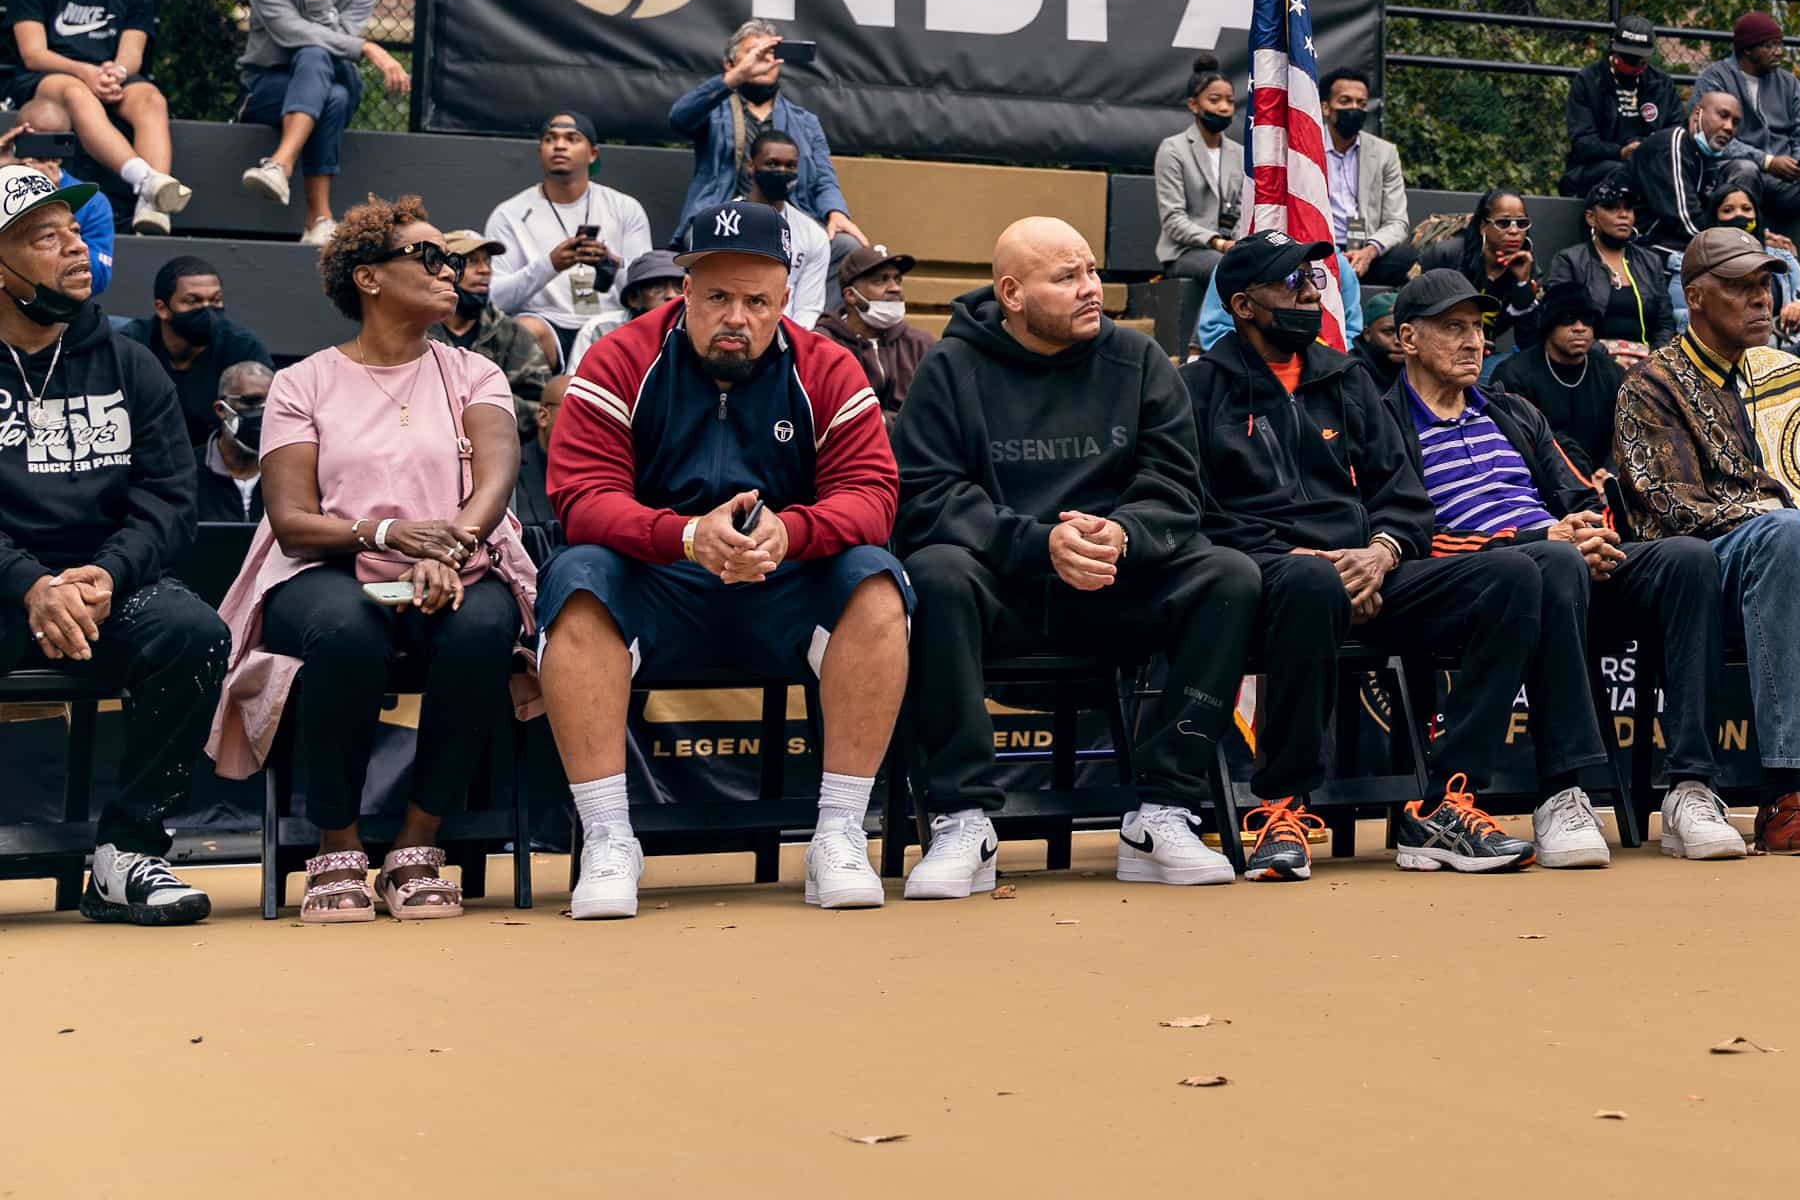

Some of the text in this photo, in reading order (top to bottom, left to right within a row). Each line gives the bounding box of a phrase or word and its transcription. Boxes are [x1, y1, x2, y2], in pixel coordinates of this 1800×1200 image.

[63, 1, 105, 25] NIKE
[991, 425, 1129, 463] SSENTIAS
[28, 454, 131, 473] RUCKER PARK
[653, 737, 806, 757] LEGENS
